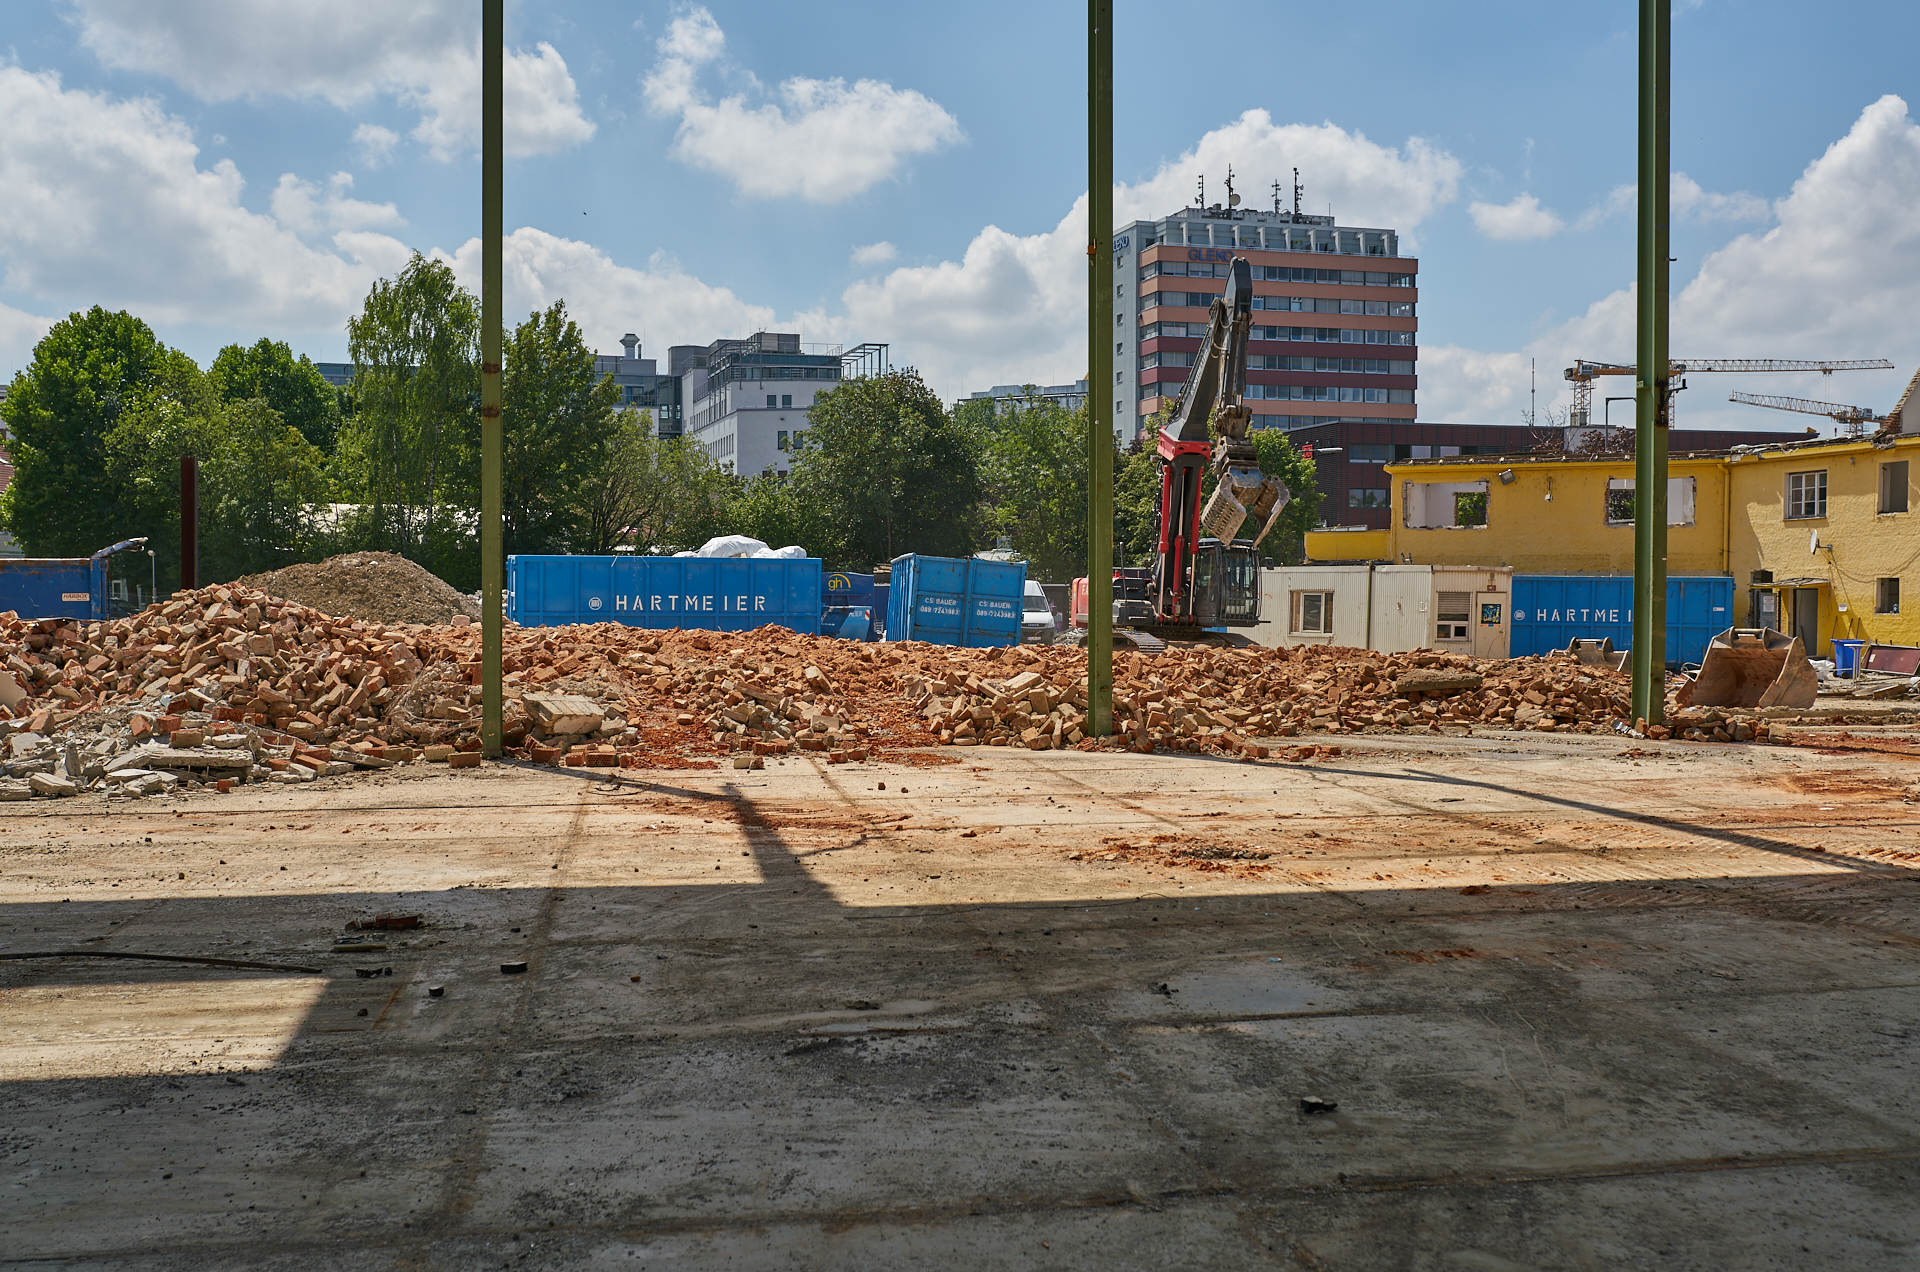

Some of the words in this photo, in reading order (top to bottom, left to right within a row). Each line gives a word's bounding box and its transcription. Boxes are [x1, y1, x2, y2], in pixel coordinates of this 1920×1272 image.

[1113, 235, 1129, 251] LEKO
[1188, 248, 1234, 262] GLEKO
[616, 595, 765, 611] HARTMEIER
[935, 598, 957, 606] BAUER
[1537, 608, 1632, 622] HARTMEI
